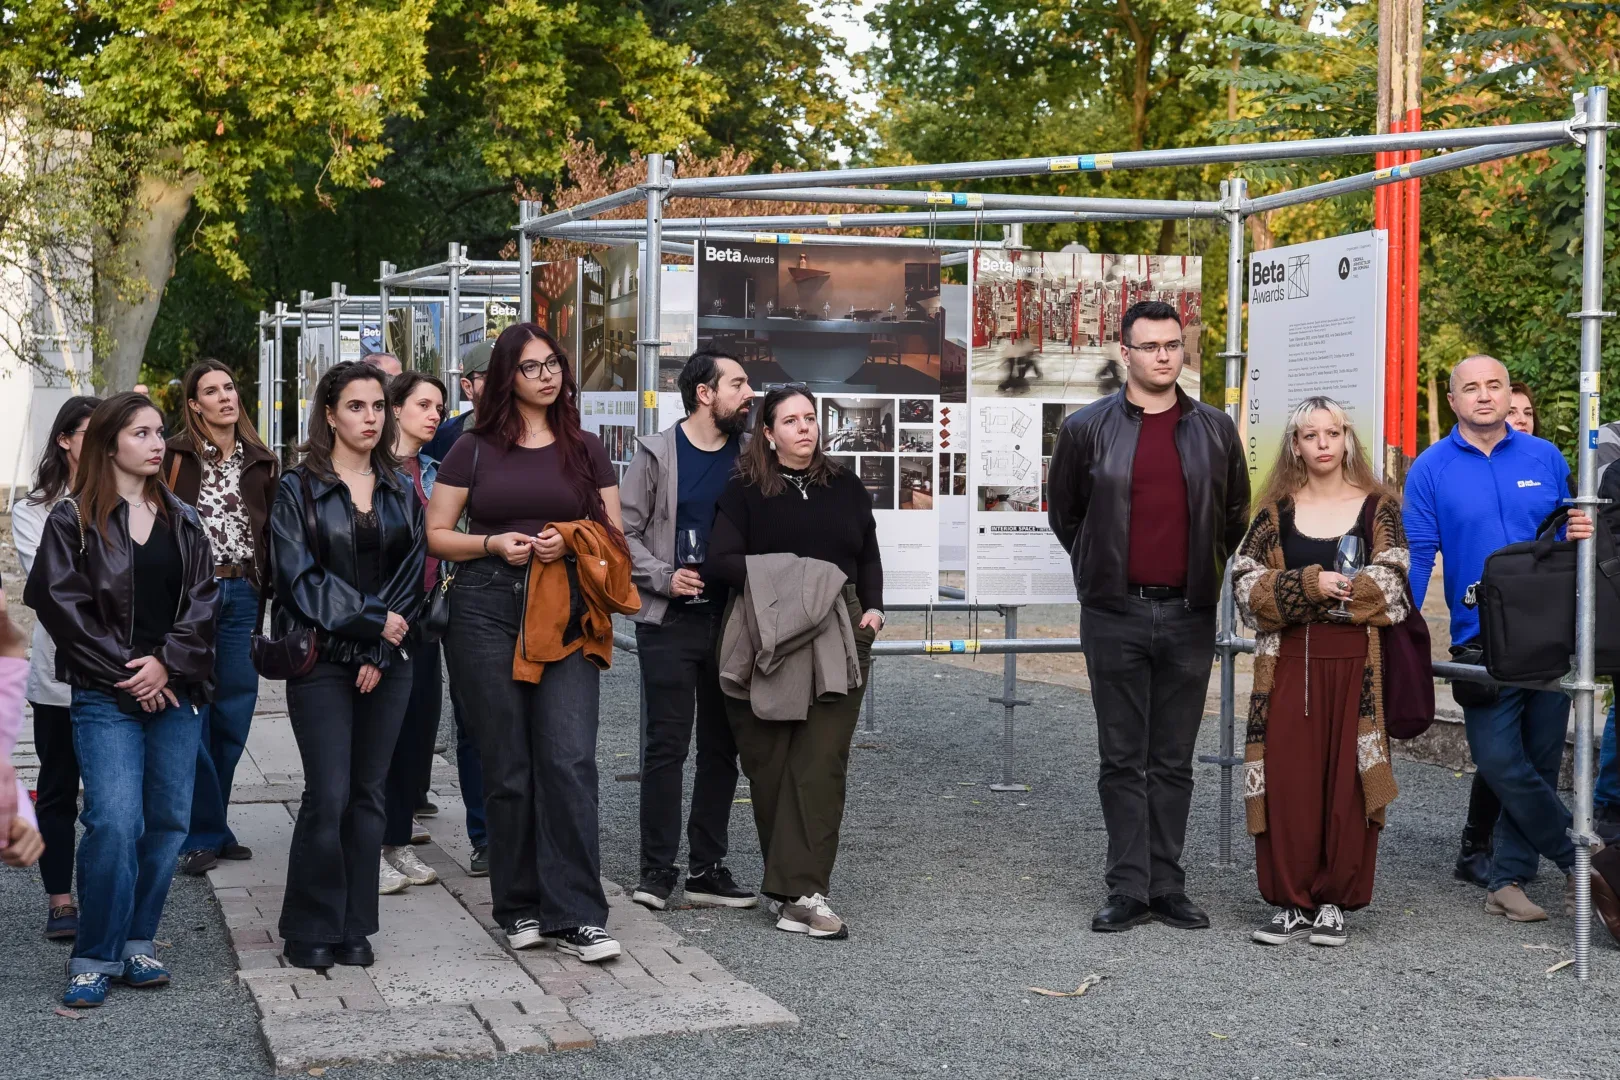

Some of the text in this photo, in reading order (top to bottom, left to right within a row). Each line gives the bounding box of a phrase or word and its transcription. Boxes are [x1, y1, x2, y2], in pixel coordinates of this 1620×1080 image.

[706, 246, 775, 264] Beta Awards
[980, 258, 1045, 274] Beta Awards
[1252, 260, 1285, 287] Beta
[1252, 284, 1285, 304] Awards
[491, 304, 517, 316] Beta
[1249, 436, 1259, 475] oct
